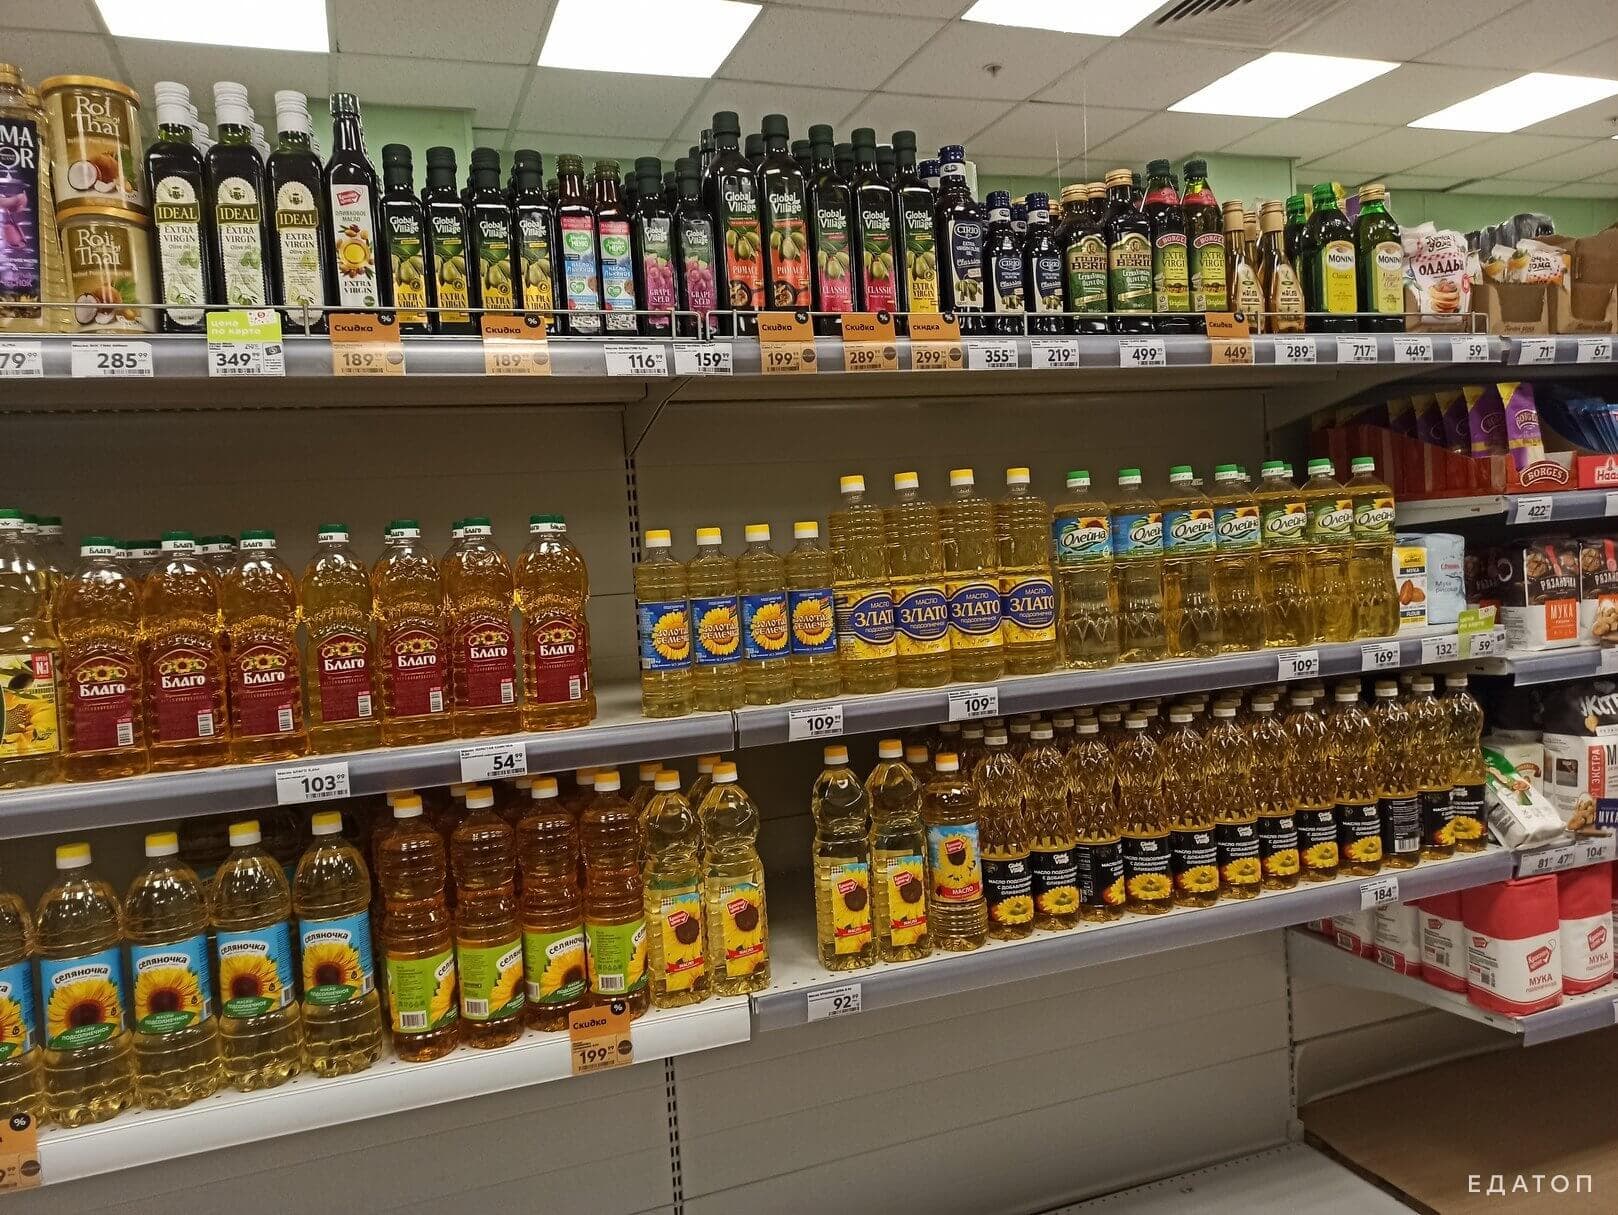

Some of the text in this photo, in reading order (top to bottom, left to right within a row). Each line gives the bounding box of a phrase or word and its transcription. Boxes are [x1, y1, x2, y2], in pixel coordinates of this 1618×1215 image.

[725, 191, 751, 204] Global
[769, 193, 796, 205] Global
[728, 200, 757, 213] Village
[771, 202, 802, 215] Village
[158, 209, 198, 220] IDEAL
[219, 209, 258, 220] IDEAL
[279, 214, 315, 225] IDEAL
[817, 208, 843, 220] Global
[862, 210, 888, 222] Global
[905, 210, 931, 222] Global
[390, 216, 415, 226] Global
[432, 216, 457, 226] Global
[480, 220, 505, 230] Global
[519, 220, 543, 229] Global
[820, 217, 847, 230] Village
[865, 219, 891, 231] Village
[909, 219, 934, 231] Village
[164, 226, 193, 235] EXTRA
[226, 226, 255, 235] EXTRA
[392, 223, 419, 234] Village
[436, 223, 462, 235] Village
[482, 228, 508, 239] Village
[522, 227, 547, 238] Village
[644, 226, 665, 236] Global
[685, 229, 706, 238] Global
[957, 225, 979, 235] CIRIO
[163, 234, 196, 243] VIRGIN
[225, 234, 257, 243] VIRGIN
[285, 233, 313, 242] EXTRA
[284, 240, 315, 250] VIRGIN
[1162, 251, 1185, 260] EXTR
[1000, 260, 1021, 269] CIRIO
[1041, 261, 1060, 270] CIRIO
[344, 280, 372, 288] EXTRA
[867, 285, 893, 295] CLASSIC
[912, 281, 935, 291] EXTRA
[440, 292, 466, 301] EXTRA
[649, 288, 672, 297] GRAPE
[691, 290, 712, 300] GRAPE
[822, 286, 849, 295] CLASSIC
[913, 290, 936, 298] VIRGIN
[396, 293, 424, 302] EXTRA
[485, 296, 511, 305] EXTRA
[525, 294, 551, 303] EXTRA
[652, 295, 671, 304] SEED
[694, 298, 712, 306] SEED
[211, 320, 239, 330] цена
[334, 324, 374, 333] Скидка
[484, 326, 521, 335] Скидка
[761, 323, 793, 332] Скидка
[844, 323, 875, 332] Скидка
[912, 323, 941, 332] скидка
[211, 327, 262, 338] по карте
[1047, 348, 1071, 361] 219
[1132, 347, 1157, 361] 499
[1223, 347, 1247, 359] 449
[1286, 345, 1309, 358] 289
[1352, 344, 1372, 357] 717
[1405, 345, 1427, 357] 449
[1468, 344, 1482, 356] 59
[1539, 346, 1550, 358] 71
[1594, 345, 1606, 357] 67
[97, 353, 138, 369] 285
[216, 352, 252, 367] 349
[342, 353, 373, 367] 189
[493, 353, 521, 367] 189
[627, 354, 656, 368] 116
[694, 352, 722, 367] 159
[767, 352, 793, 366] 199
[849, 351, 875, 365] 289
[916, 351, 942, 364] 299
[985, 350, 1009, 363] 355
[1528, 466, 1563, 480] BORGES
[1597, 470, 1618, 482] Haa
[1528, 505, 1546, 517] 422
[1062, 529, 1107, 549] Олейна
[965, 592, 989, 600] МАСЛО
[1024, 587, 1047, 595] МАСЛО
[870, 601, 890, 609] МАСЛО
[914, 597, 938, 606] МАСЛО
[1009, 595, 1055, 612] ЗЛАТО
[900, 605, 948, 624] ЗЛАТО
[951, 600, 1001, 618] ЗЛАТО
[1550, 603, 1574, 620] МУКА
[854, 609, 895, 628] ЗЛАТ
[1435, 643, 1454, 656] 132
[1478, 640, 1490, 651] 59
[1373, 650, 1394, 666] 169
[1291, 659, 1313, 673] 109
[965, 697, 990, 713] 109
[807, 716, 834, 731] 109
[494, 754, 516, 771] 54
[1591, 749, 1602, 784] ЭКСТРА
[300, 775, 337, 795] 103
[1586, 846, 1603, 858] 104
[1557, 853, 1569, 866] 47
[952, 885, 976, 897] МАСЛО
[1373, 885, 1393, 901] 184
[1588, 952, 1609, 966] МУКА
[1529, 972, 1554, 987] МУКА
[833, 995, 852, 1011] 92
[573, 1017, 607, 1032] Скидка
[579, 1047, 608, 1065] 199
